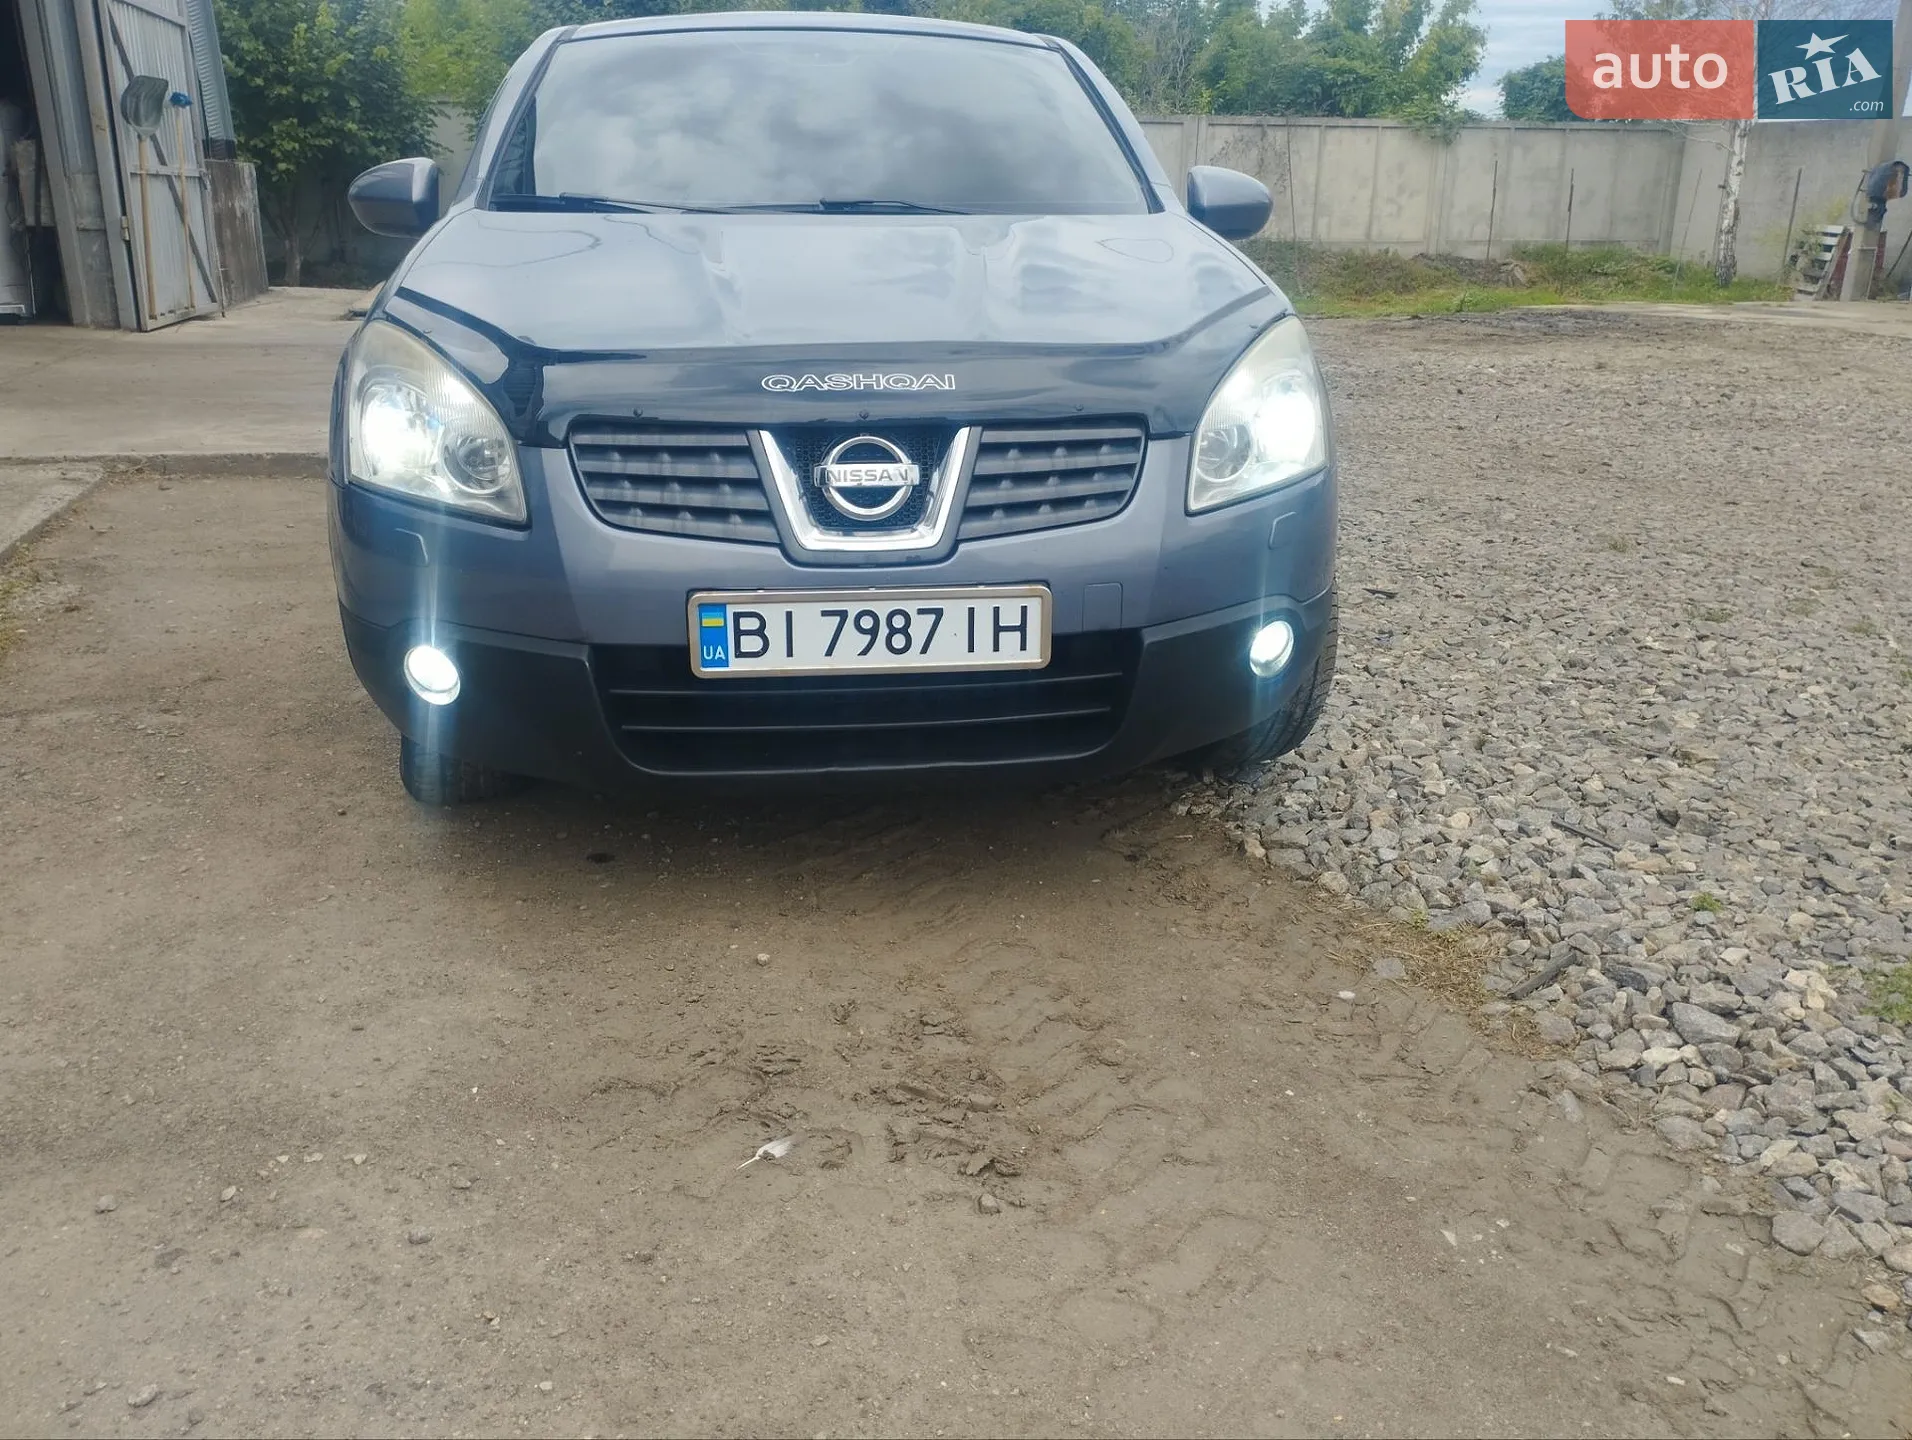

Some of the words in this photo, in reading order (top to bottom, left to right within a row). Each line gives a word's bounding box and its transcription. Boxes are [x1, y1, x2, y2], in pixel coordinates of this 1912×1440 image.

[761, 373, 956, 392] QASHQAI
[826, 468, 908, 483] NISSAN
[732, 610, 794, 659] BI
[820, 607, 944, 657] 7987
[966, 605, 1028, 653] IH
[703, 646, 726, 661] UA
